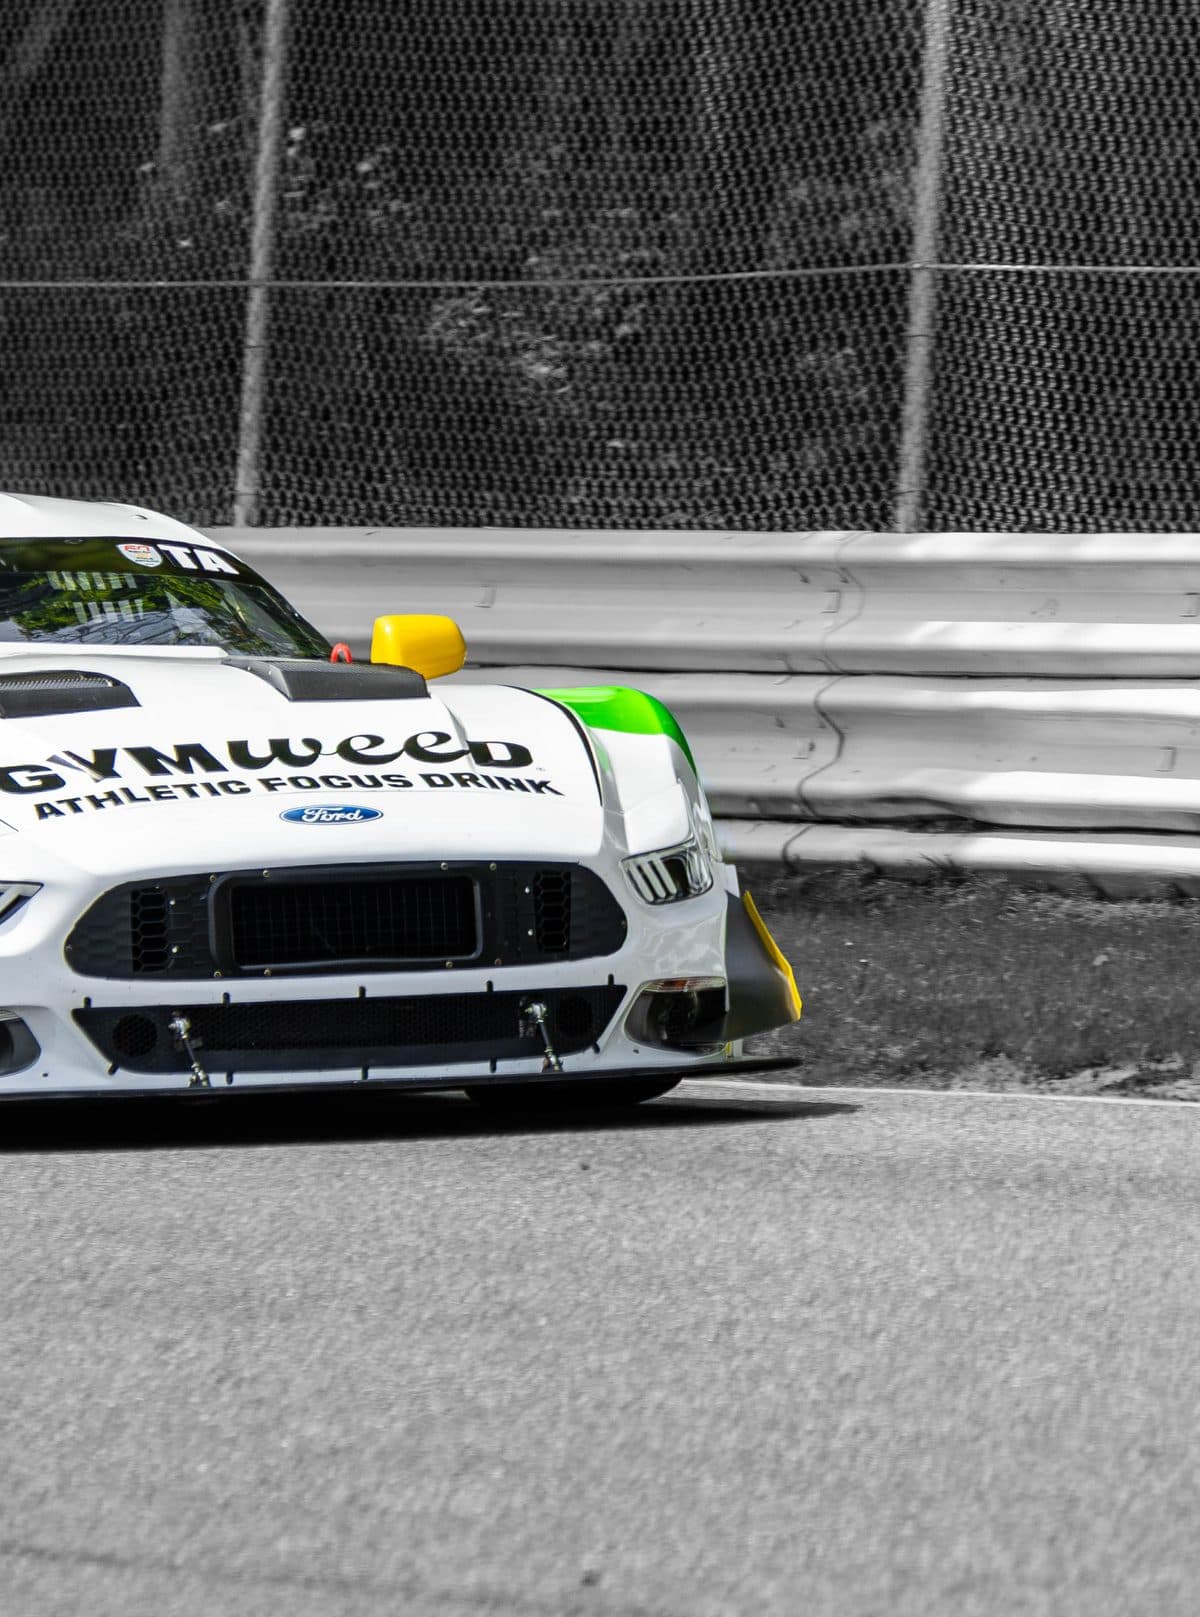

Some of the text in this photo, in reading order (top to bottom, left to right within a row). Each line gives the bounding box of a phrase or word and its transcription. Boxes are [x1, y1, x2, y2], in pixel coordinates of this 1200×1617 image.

[156, 543, 241, 575] TA
[33, 770, 565, 821] ATHLETIC FOCUS DRINK
[299, 805, 363, 824] Ford
